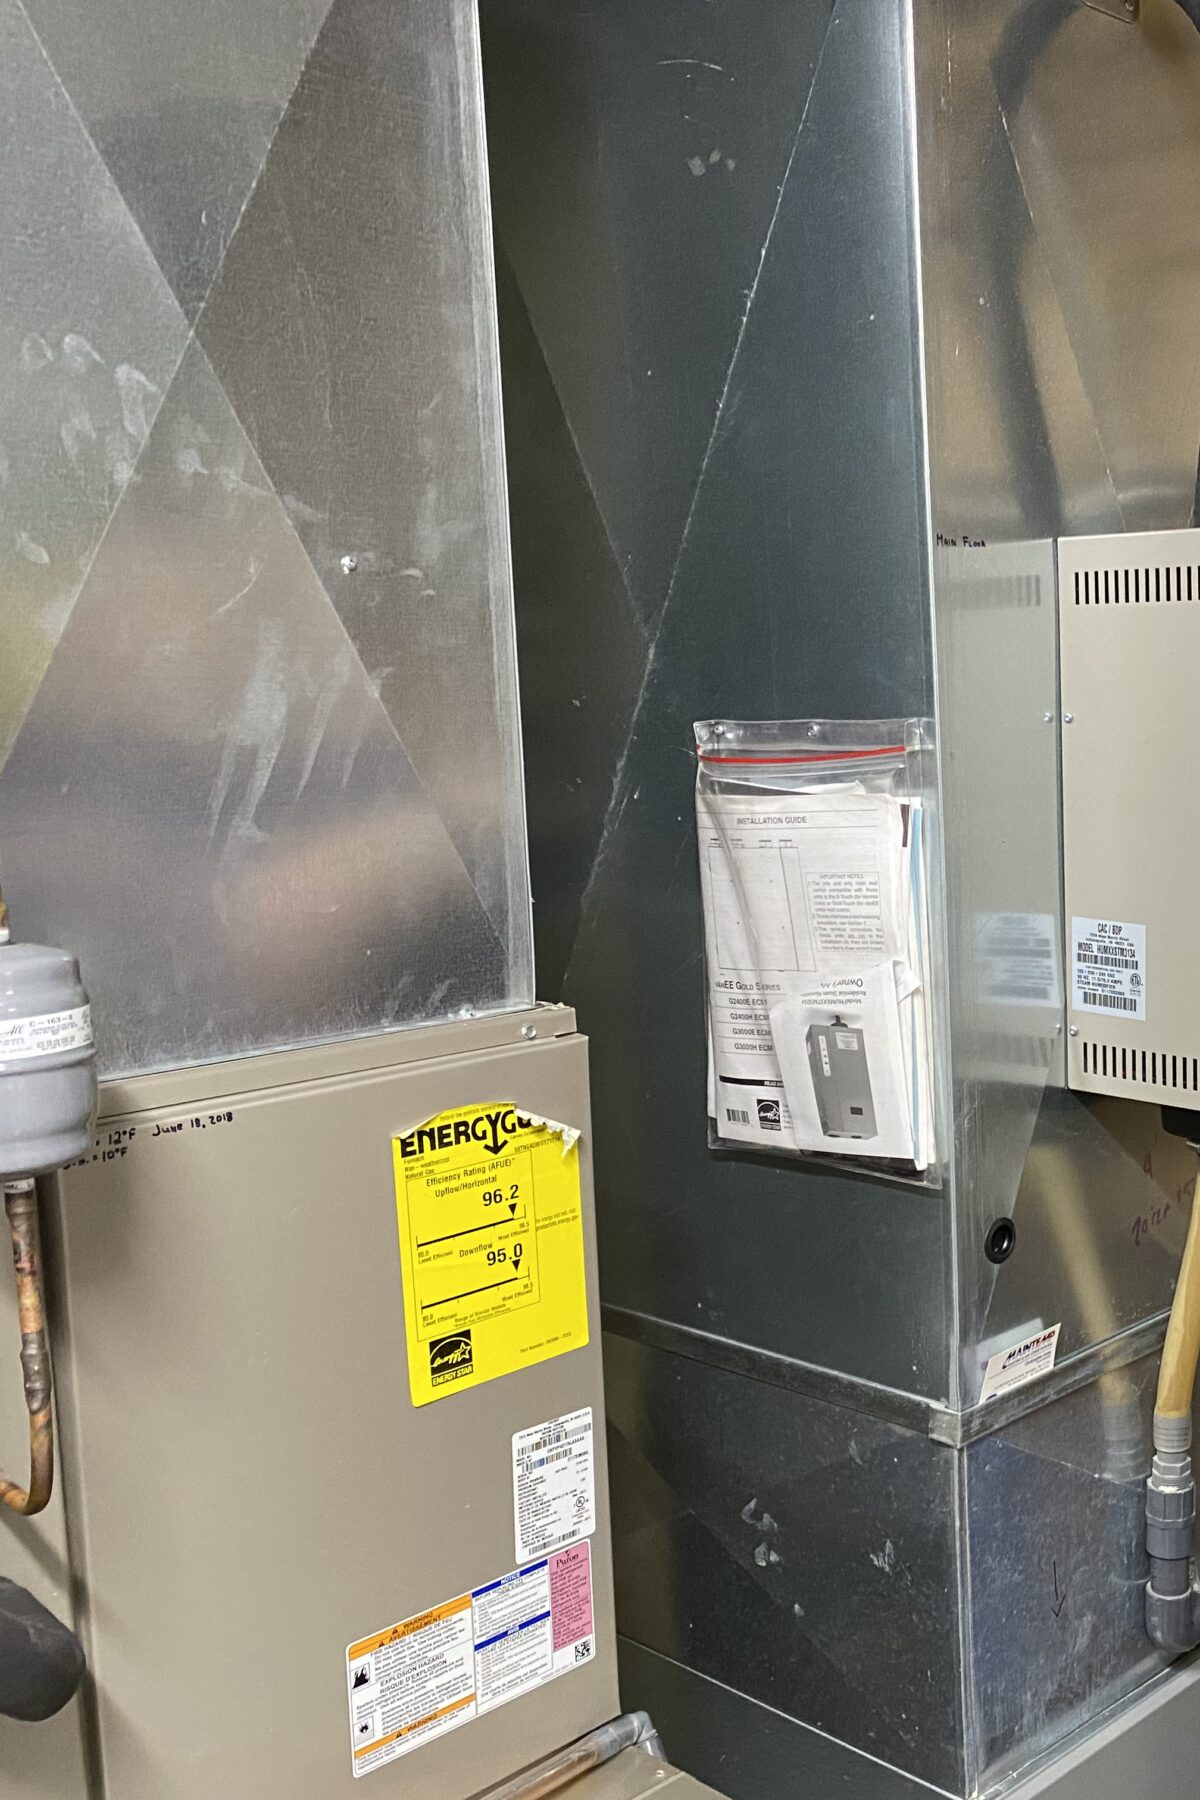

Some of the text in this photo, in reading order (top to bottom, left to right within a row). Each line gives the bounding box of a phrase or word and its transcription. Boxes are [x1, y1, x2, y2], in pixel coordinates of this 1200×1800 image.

[737, 816, 807, 825] INSTALLATION GUIDE
[1098, 923, 1107, 933] CAC
[1078, 942, 1094, 953] MODEL
[152, 1123, 183, 1137] June
[209, 1112, 233, 1126] 2018
[405, 1170, 424, 1179] Natural
[426, 1172, 460, 1187] Efficiency
[463, 1166, 486, 1179] Rating
[434, 1174, 497, 1198] Upflow/Horizontal
[483, 1184, 519, 1207] 96.2
[459, 1243, 493, 1257] Downflow
[487, 1243, 523, 1266] 95.0
[432, 1365, 473, 1386] ENERGY STAR
[555, 1552, 579, 1569] Puron
[501, 1572, 520, 1585] NOTICE
[389, 1615, 441, 1643] AVERTISSEMENT
[404, 1611, 433, 1630] WARNING
[380, 1652, 444, 1688] EXPLOSION HAZARD
[380, 1658, 447, 1695] RISQUE D'EXPLOSION
[408, 1713, 437, 1733] WARNING
